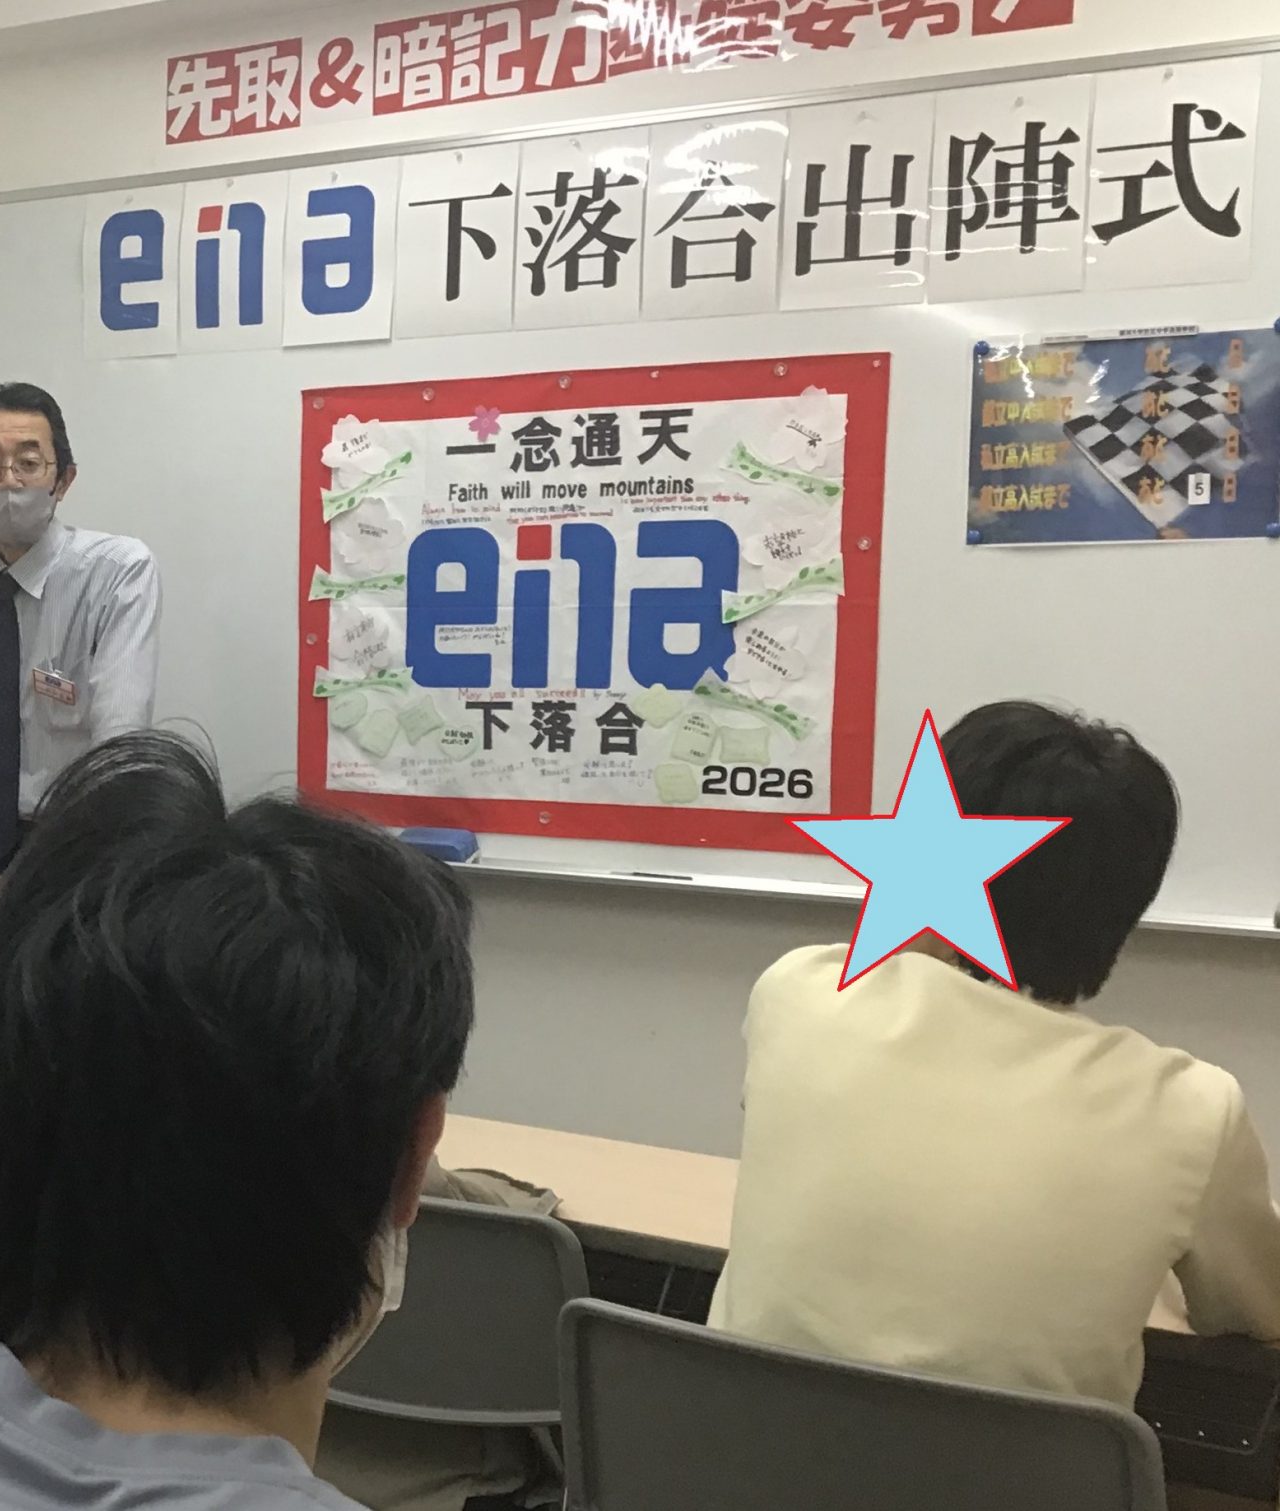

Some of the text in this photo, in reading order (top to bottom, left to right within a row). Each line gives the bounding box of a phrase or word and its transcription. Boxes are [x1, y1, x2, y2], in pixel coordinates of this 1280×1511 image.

[99, 103, 1246, 330] ena 下落合出陣式
[446, 408, 693, 472] 一念通天
[448, 476, 694, 502] Faith will move mountains
[1194, 482, 1205, 496] 5
[407, 519, 739, 691] ena
[466, 700, 645, 756] 下落合
[701, 765, 814, 798] 2026
